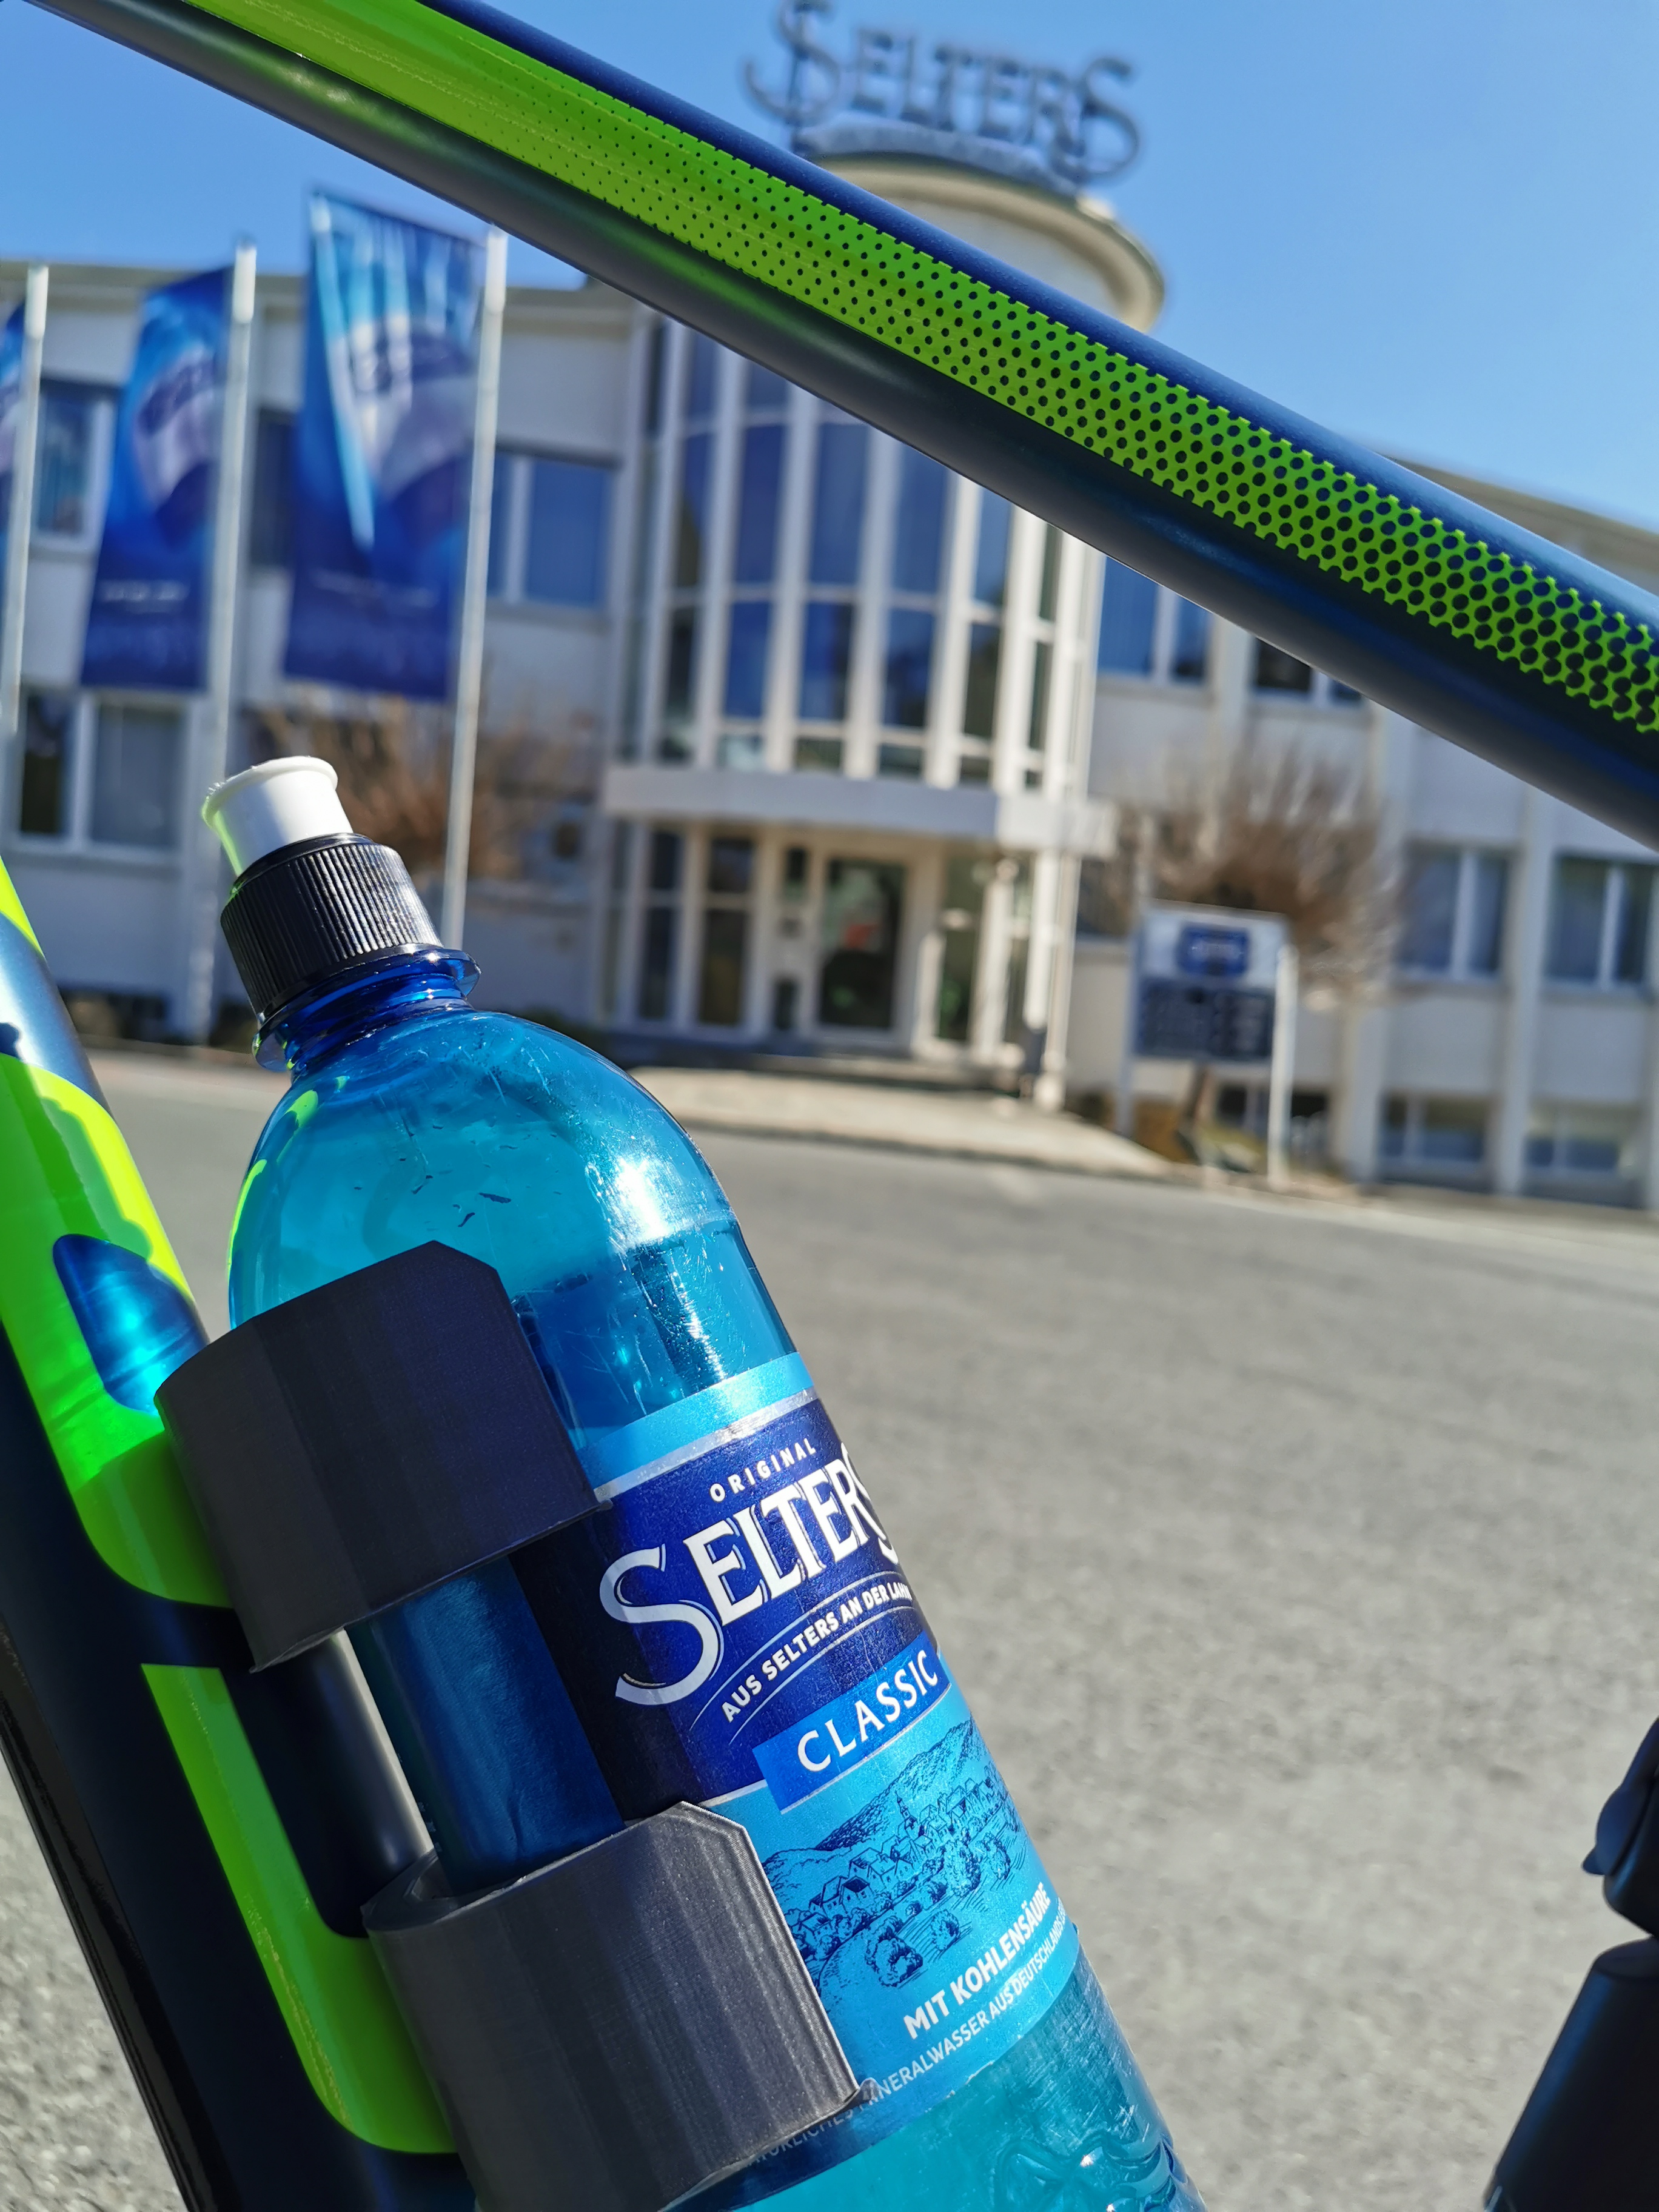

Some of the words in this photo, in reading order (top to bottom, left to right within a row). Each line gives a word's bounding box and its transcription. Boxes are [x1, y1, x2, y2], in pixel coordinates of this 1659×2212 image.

[741, 0, 1141, 179] SELTERS
[709, 1438, 816, 1502] ORIGINAL
[599, 1442, 899, 1706] SELTERS
[721, 1674, 762, 1723] AUS
[762, 1611, 840, 1681] SELTERS
[839, 1597, 863, 1624] AN
[862, 1583, 890, 1609] DER
[797, 1649, 938, 1772] CLASSIC
[903, 1989, 950, 2039] MIT
[950, 1882, 1050, 2005] KOHLENSÄURE
[859, 2009, 990, 2111] NERALWASSER
[988, 1986, 1014, 2019] AUS
